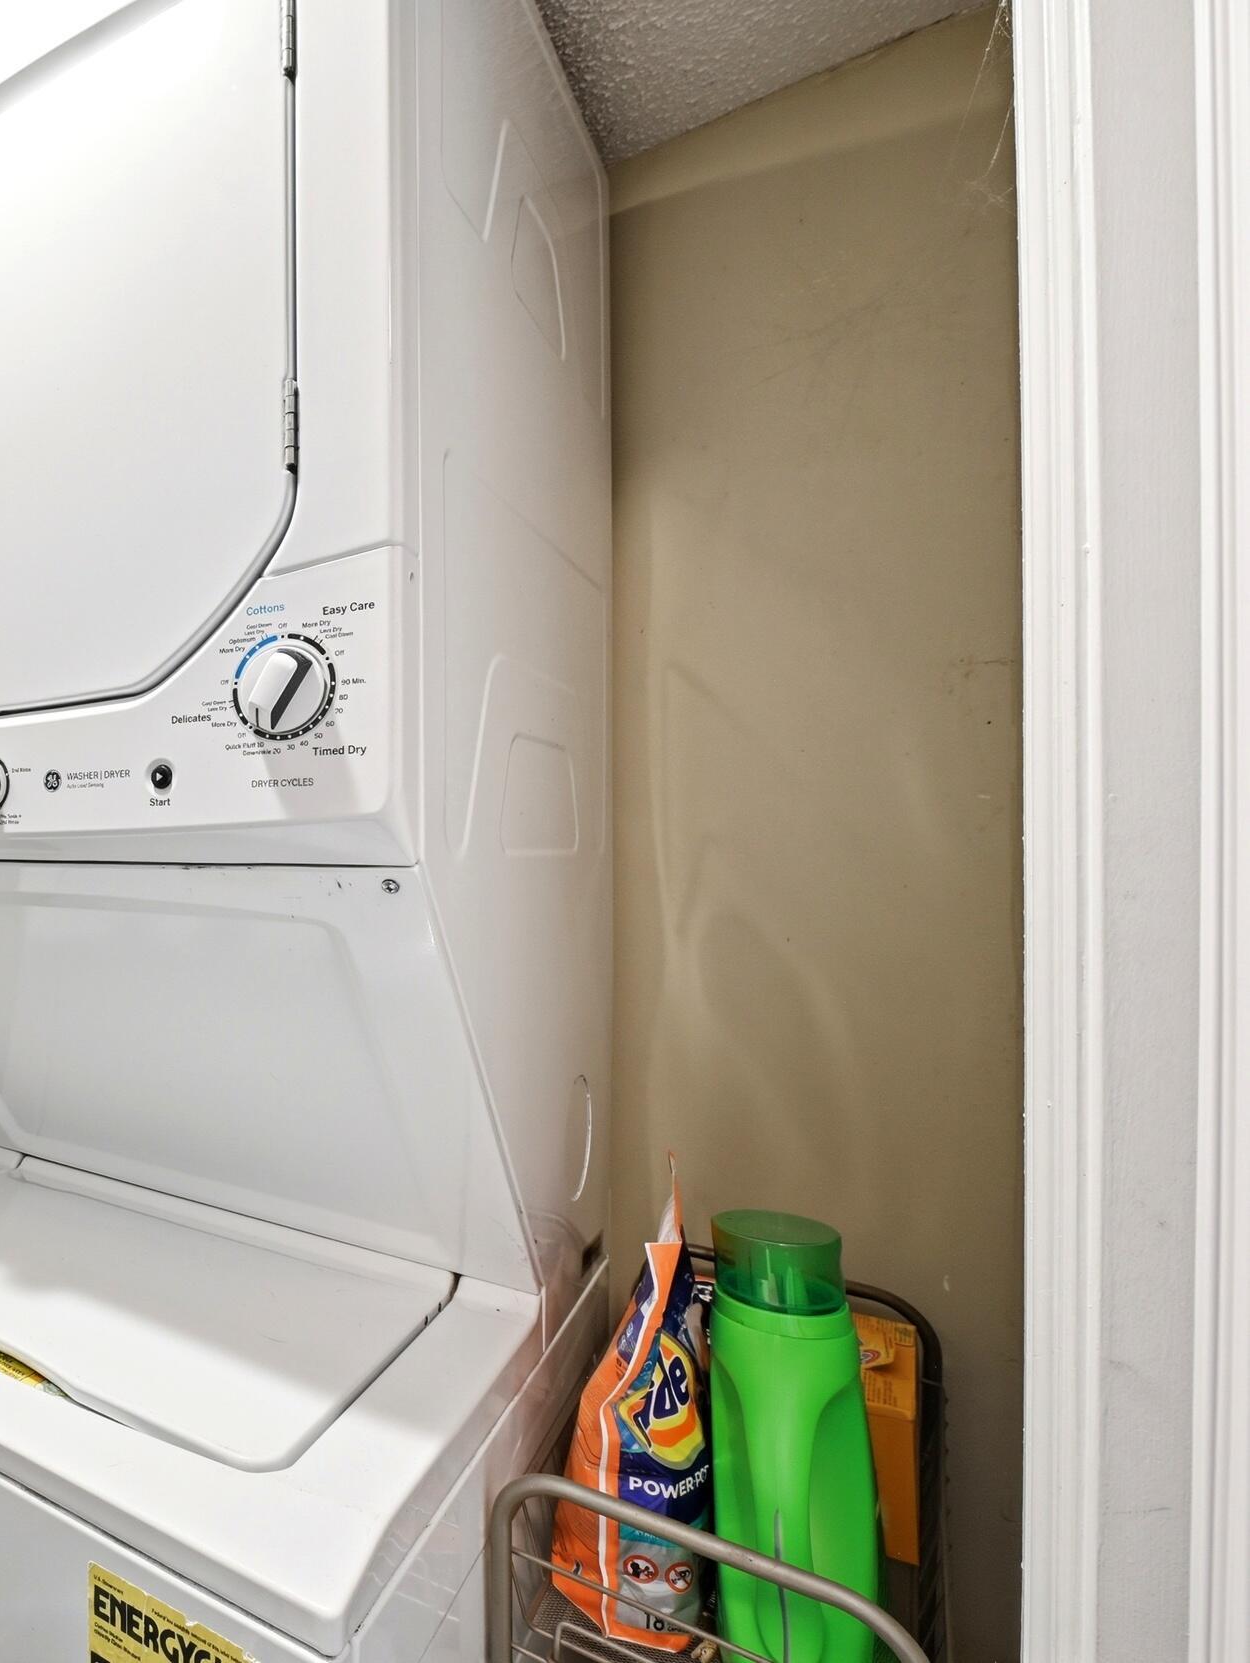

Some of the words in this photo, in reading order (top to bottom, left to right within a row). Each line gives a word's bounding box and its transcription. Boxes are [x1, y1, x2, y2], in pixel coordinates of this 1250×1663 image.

[246, 603, 285, 616] Cottons
[322, 606, 347, 616] Easy
[349, 601, 375, 612] Care
[302, 621, 318, 629] More
[319, 619, 331, 627] Dry
[234, 645, 246, 653] Dry
[341, 678, 351, 686] 90
[171, 714, 212, 725] Delicates
[325, 720, 335, 728] 60
[314, 732, 323, 740] 50
[312, 745, 345, 757] Timed
[347, 744, 367, 757] Dry
[66, 770, 99, 781] WASHER
[104, 769, 131, 779] DRYER
[251, 779, 279, 788] DRYER
[280, 777, 314, 787] CYCLES
[149, 798, 170, 806] Start
